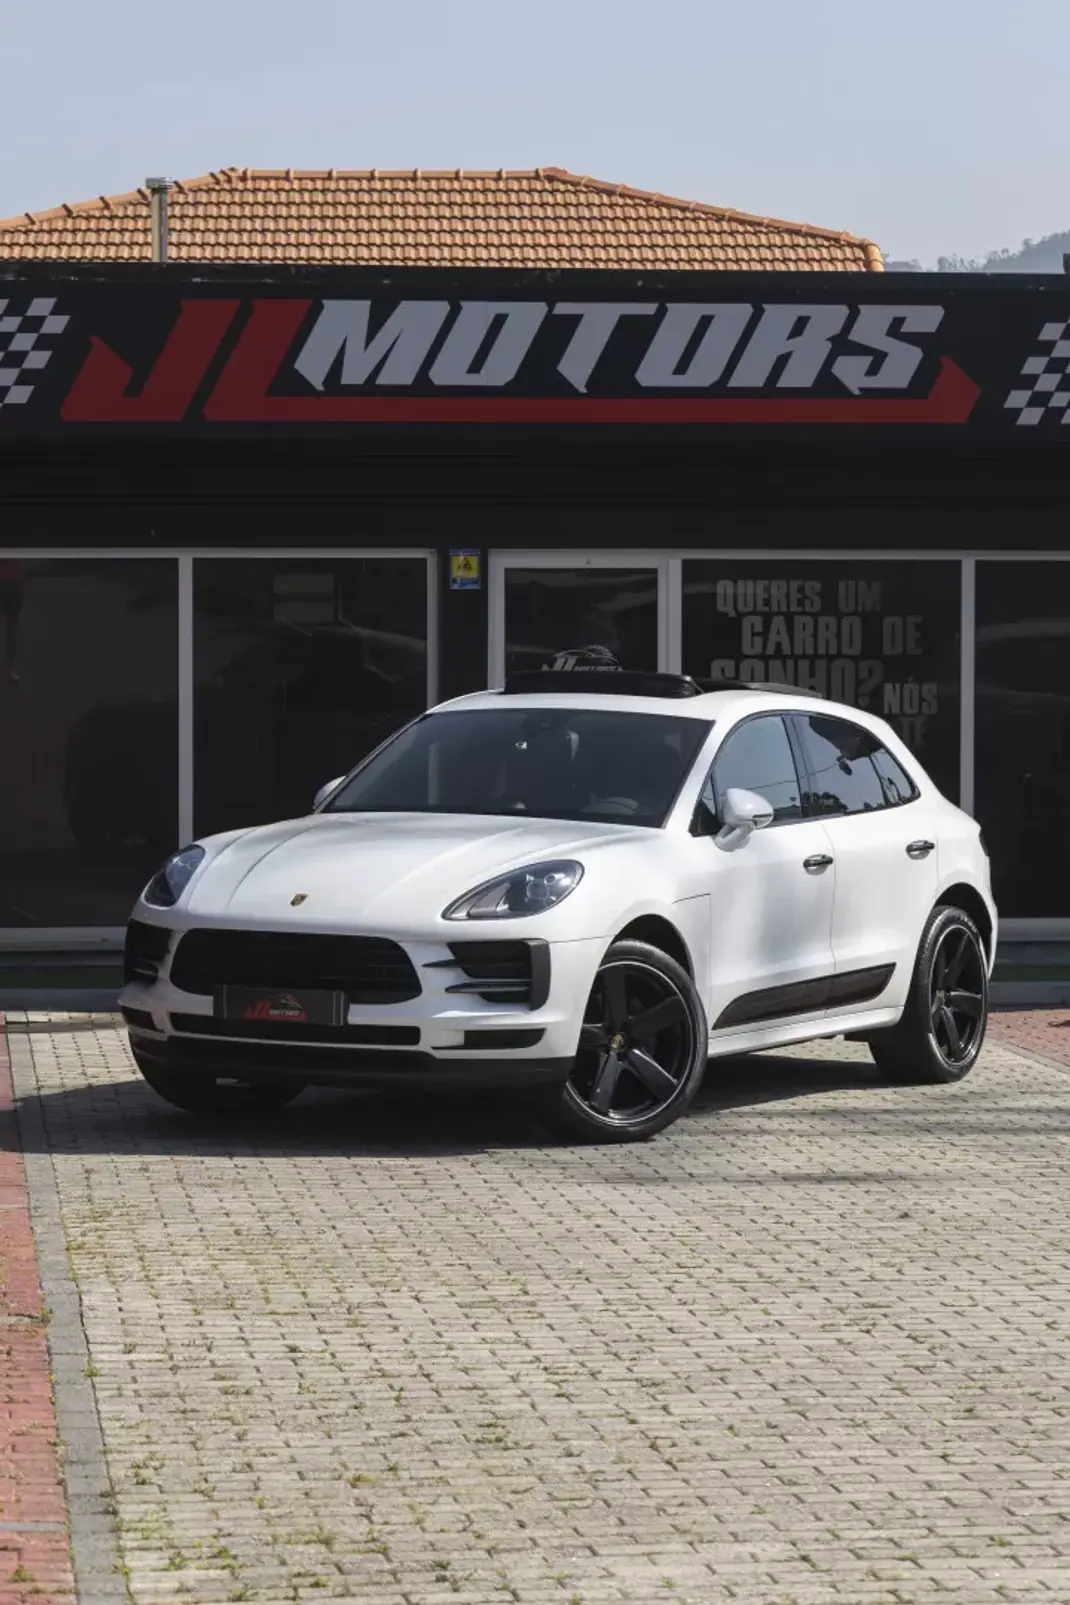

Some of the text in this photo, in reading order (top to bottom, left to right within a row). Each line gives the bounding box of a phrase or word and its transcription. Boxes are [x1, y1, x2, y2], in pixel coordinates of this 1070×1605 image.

[716, 580, 883, 617] QUERES UM
[741, 615, 923, 655] CARRO DE
[883, 676, 939, 715] NÓS
